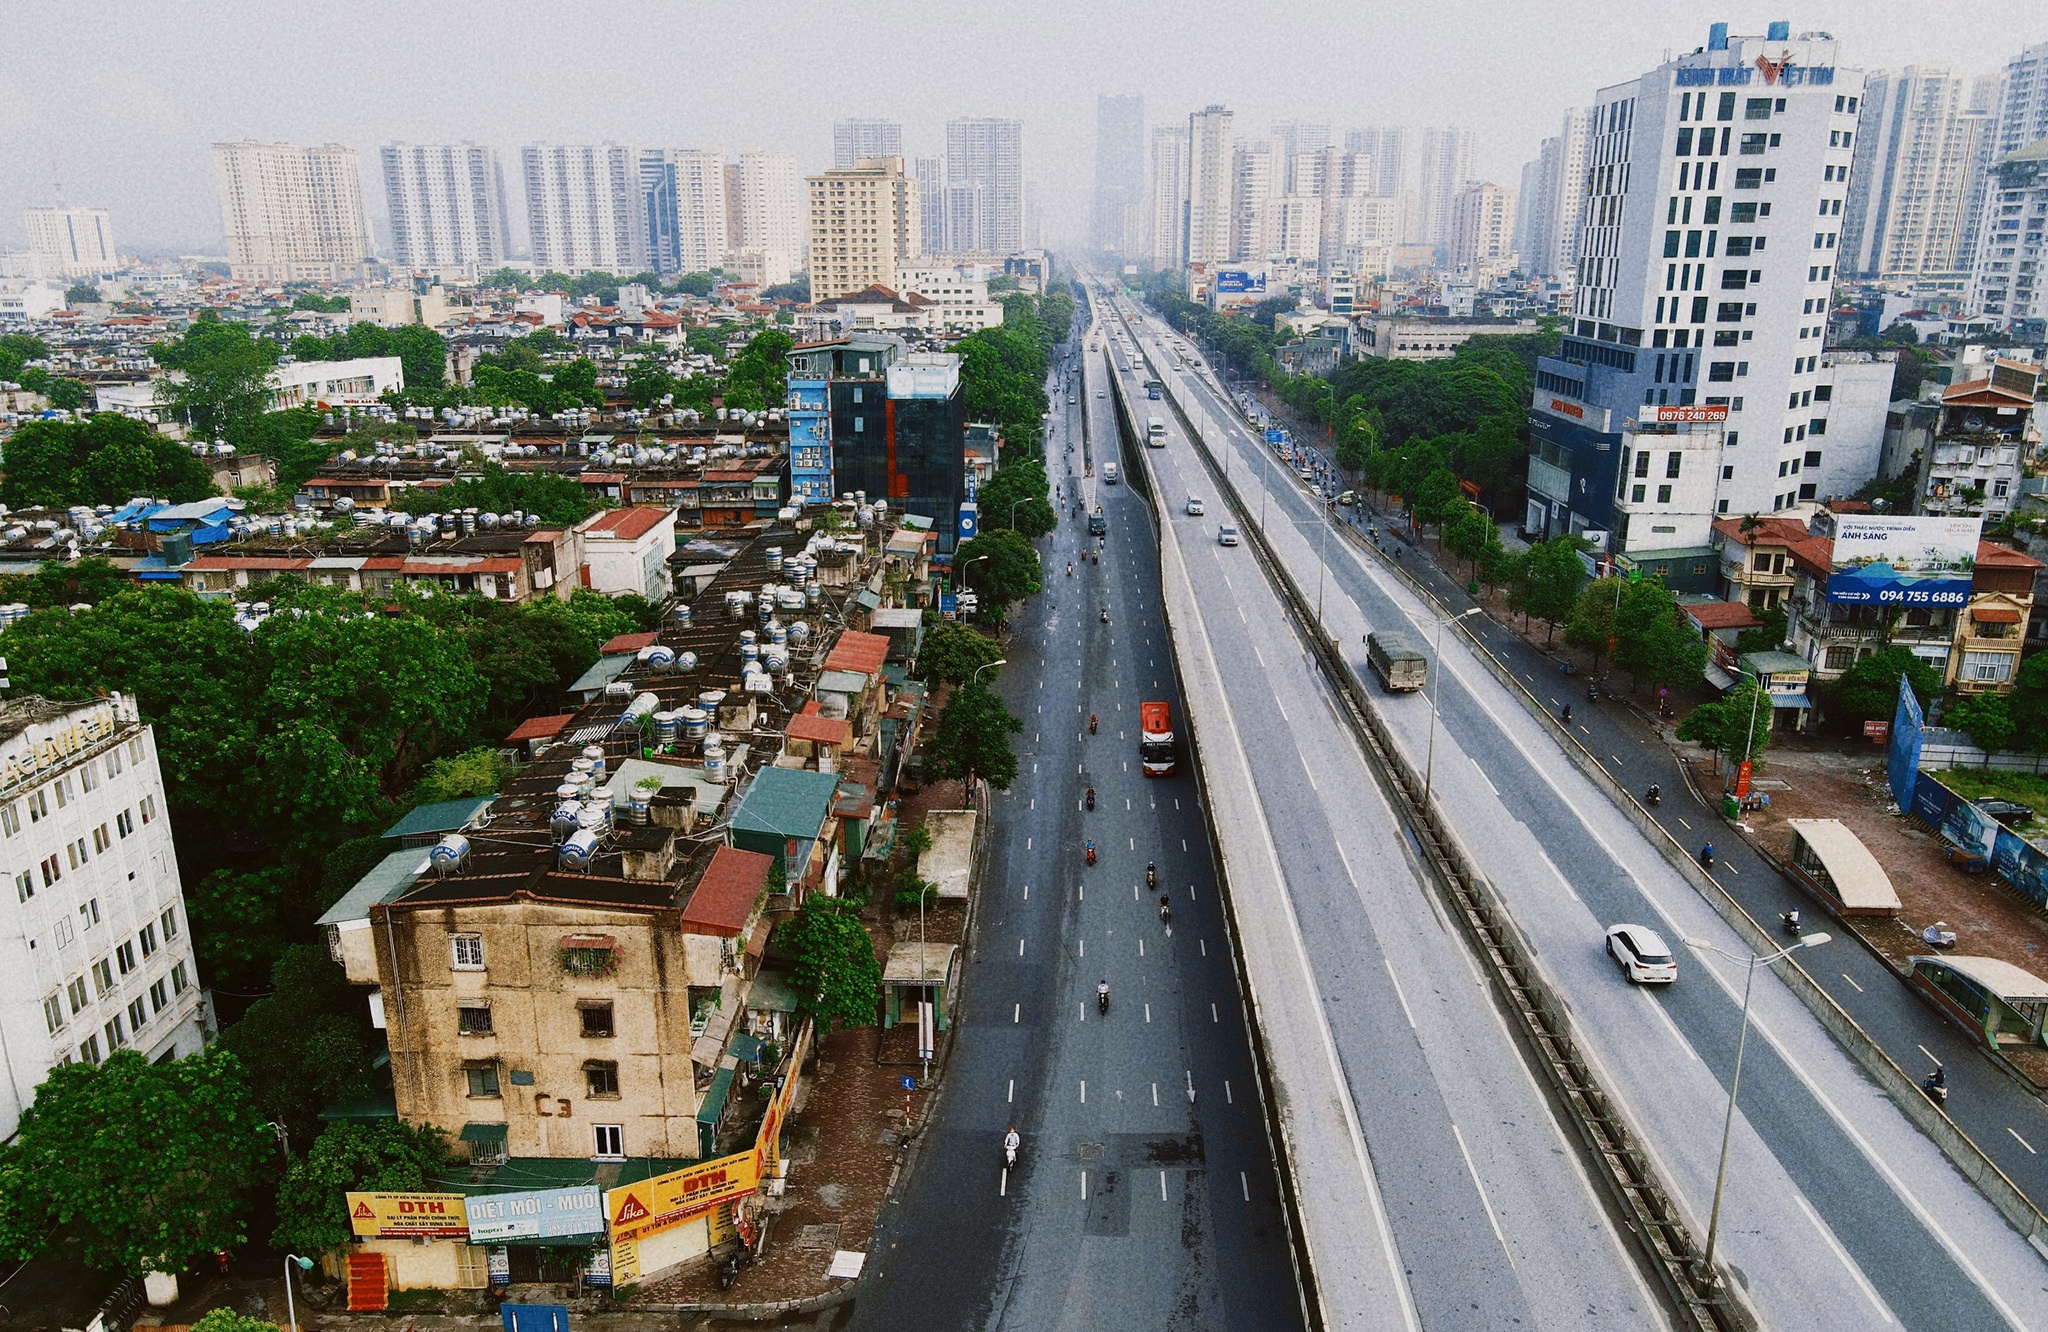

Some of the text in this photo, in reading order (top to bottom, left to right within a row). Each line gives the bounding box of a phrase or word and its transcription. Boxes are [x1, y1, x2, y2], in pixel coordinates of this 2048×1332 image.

[1660, 411, 1726, 421] 0976 240 269
[1863, 531, 1888, 541] SÁNG
[1879, 590, 1964, 603] 094 755 6886
[683, 1169, 727, 1193] DTH
[398, 1201, 445, 1214] DTH
[469, 1199, 506, 1222] DIỆT
[509, 1192, 543, 1216] MỐI
[557, 1187, 601, 1212] MUỖI
[355, 1206, 373, 1217] Sika
[619, 1202, 645, 1222] Sika
